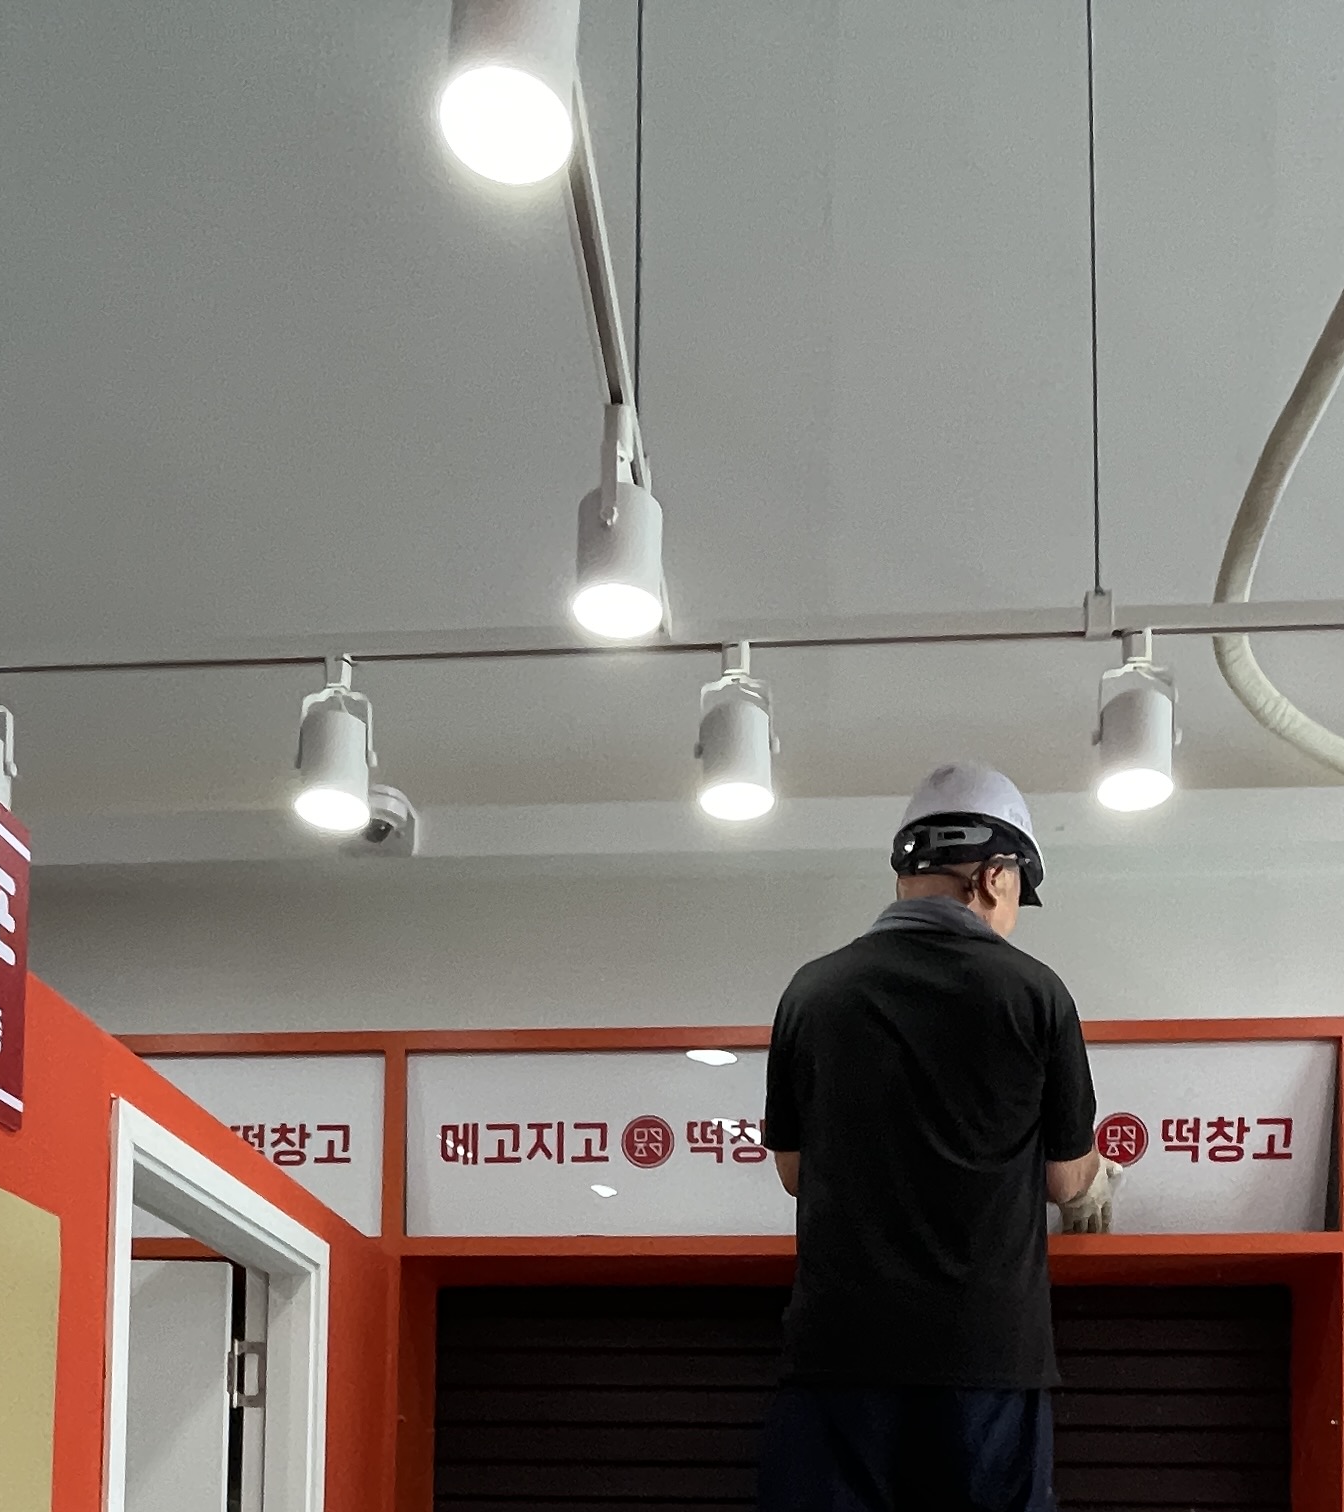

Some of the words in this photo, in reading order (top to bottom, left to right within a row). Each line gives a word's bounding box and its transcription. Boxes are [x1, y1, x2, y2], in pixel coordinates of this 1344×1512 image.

[440, 1120, 609, 1166] 메고지고
[686, 1118, 768, 1164] 떡창
[1161, 1116, 1294, 1164] 떡창고
